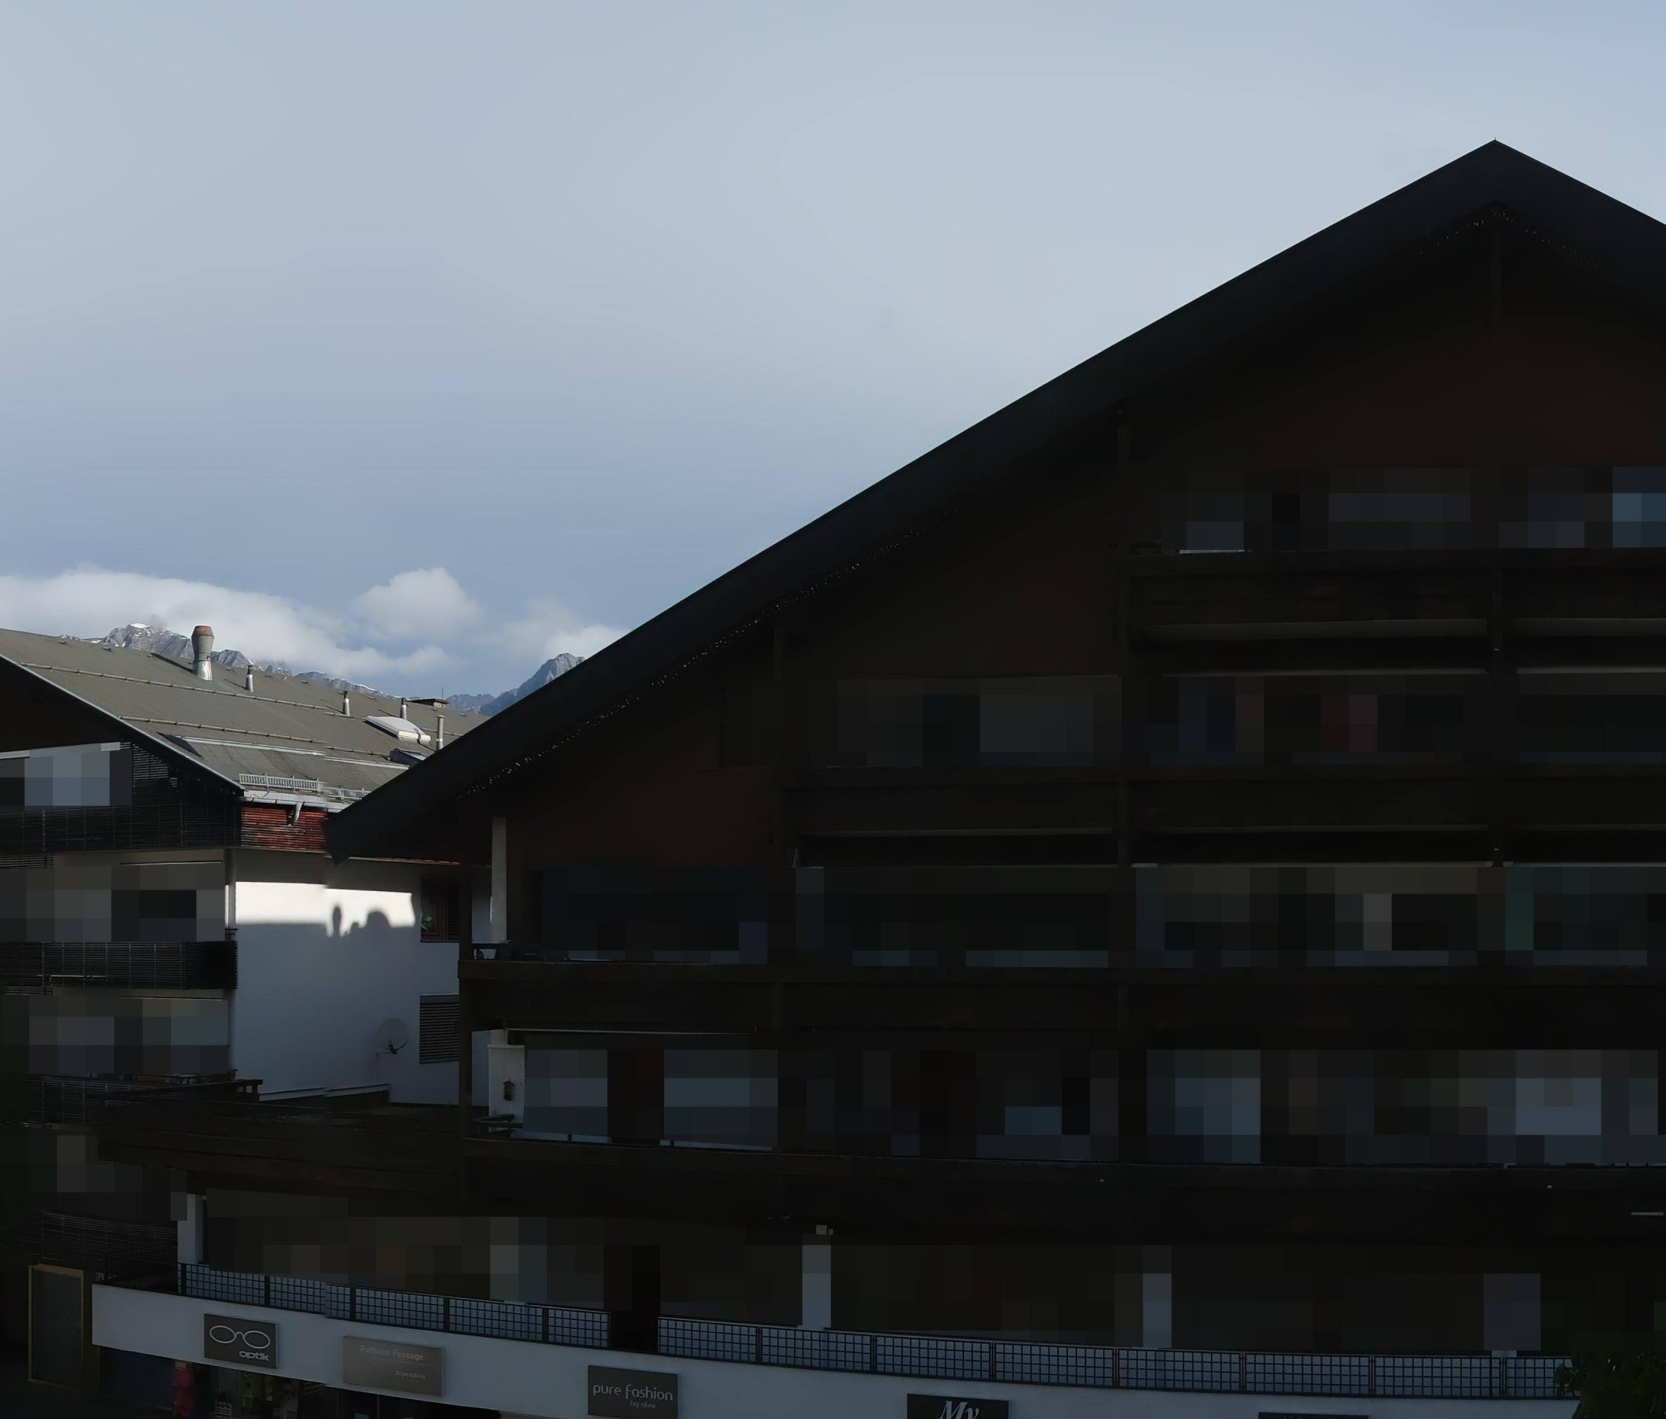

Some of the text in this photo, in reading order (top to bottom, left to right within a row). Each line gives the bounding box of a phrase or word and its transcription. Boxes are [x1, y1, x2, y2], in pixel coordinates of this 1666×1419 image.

[239, 1350, 270, 1361] optik
[392, 1348, 424, 1361] Passage
[593, 1384, 673, 1401] pure fashion
